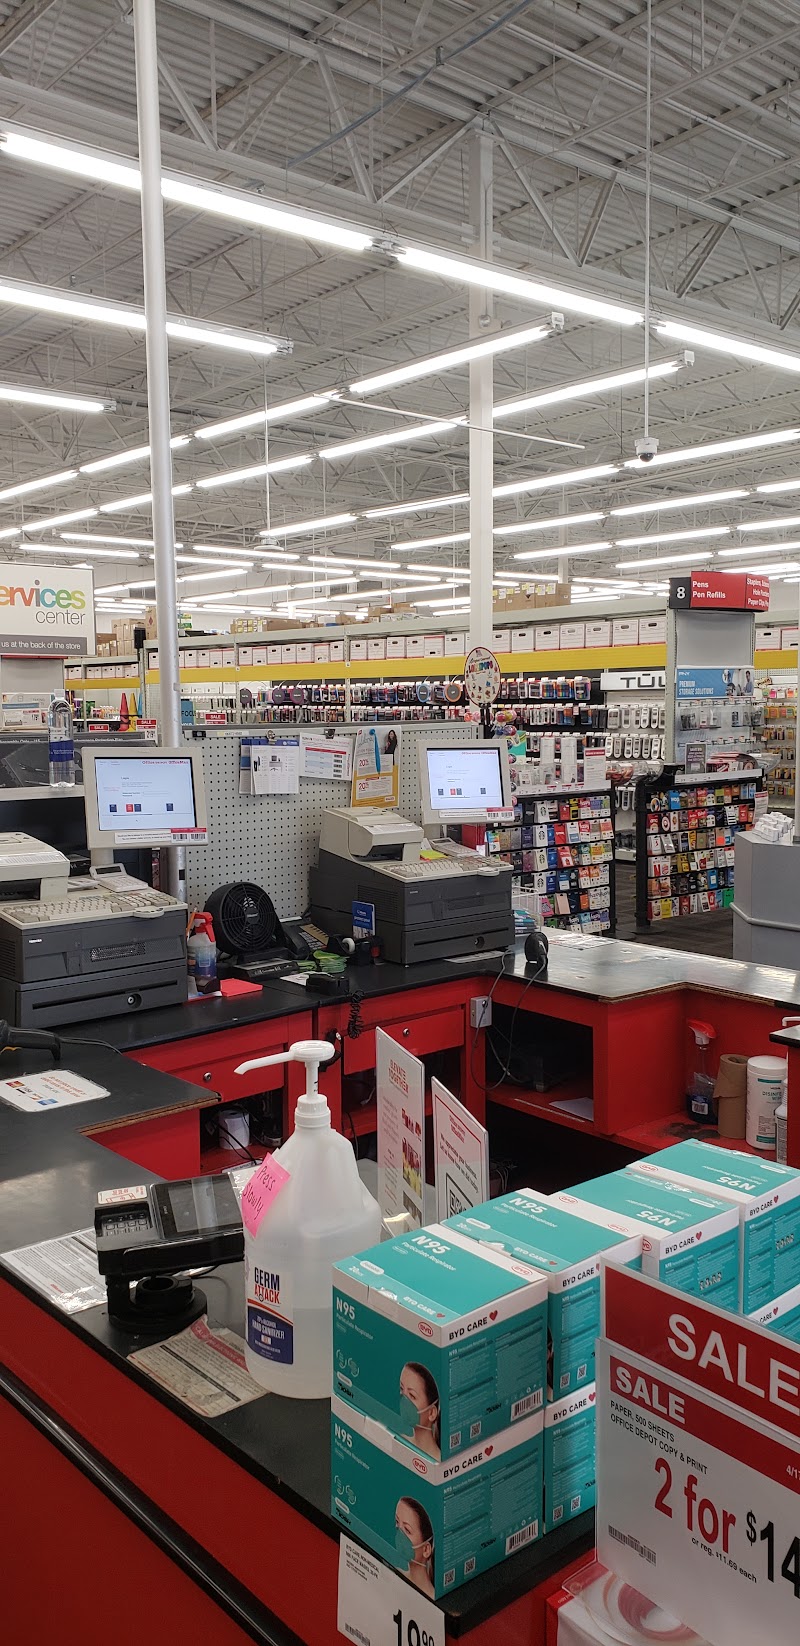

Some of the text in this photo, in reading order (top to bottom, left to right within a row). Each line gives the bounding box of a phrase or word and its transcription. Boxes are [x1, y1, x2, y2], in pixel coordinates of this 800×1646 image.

[676, 587, 686, 599] 8
[692, 580, 709, 588] Pens
[692, 590, 726, 599] Pen Refills
[35, 609, 86, 625] center
[30, 641, 46, 649] back
[257, 1165, 276, 1191] Press
[716, 1176, 756, 1191] N95
[243, 1182, 264, 1221] Slowly
[508, 1197, 548, 1214] N95
[749, 1200, 773, 1216] BYD CARE
[501, 1202, 558, 1228] Particulate Respirator
[636, 1210, 677, 1227] N95
[411, 1235, 451, 1256] N95
[665, 1237, 695, 1255] BYD CARE
[401, 1242, 457, 1272] Particulate Respirator
[254, 1266, 280, 1291] GERM
[562, 1266, 595, 1288] BYD CARE
[254, 1283, 280, 1304] ATTACK
[336, 1296, 356, 1320] N95
[417, 1301, 436, 1316] CARE
[759, 1312, 773, 1323] CARE
[262, 1325, 285, 1339] SANITIZER
[419, 1323, 432, 1337] BYD
[448, 1316, 488, 1341] BYD CARE
[667, 1313, 800, 1416] SALE
[616, 1366, 685, 1424] SALE
[553, 1398, 588, 1421] BYD CARE
[610, 1400, 675, 1443] PAPER, 500 SHEETS
[334, 1422, 353, 1449] N95
[610, 1413, 708, 1475] OFFICE DEPOT COPY & PRINT
[443, 1452, 483, 1479] BYD CARE
[654, 1457, 673, 1518] 2
[684, 1474, 737, 1555] for
[691, 1536, 757, 1584] or reg. $11.69 each
